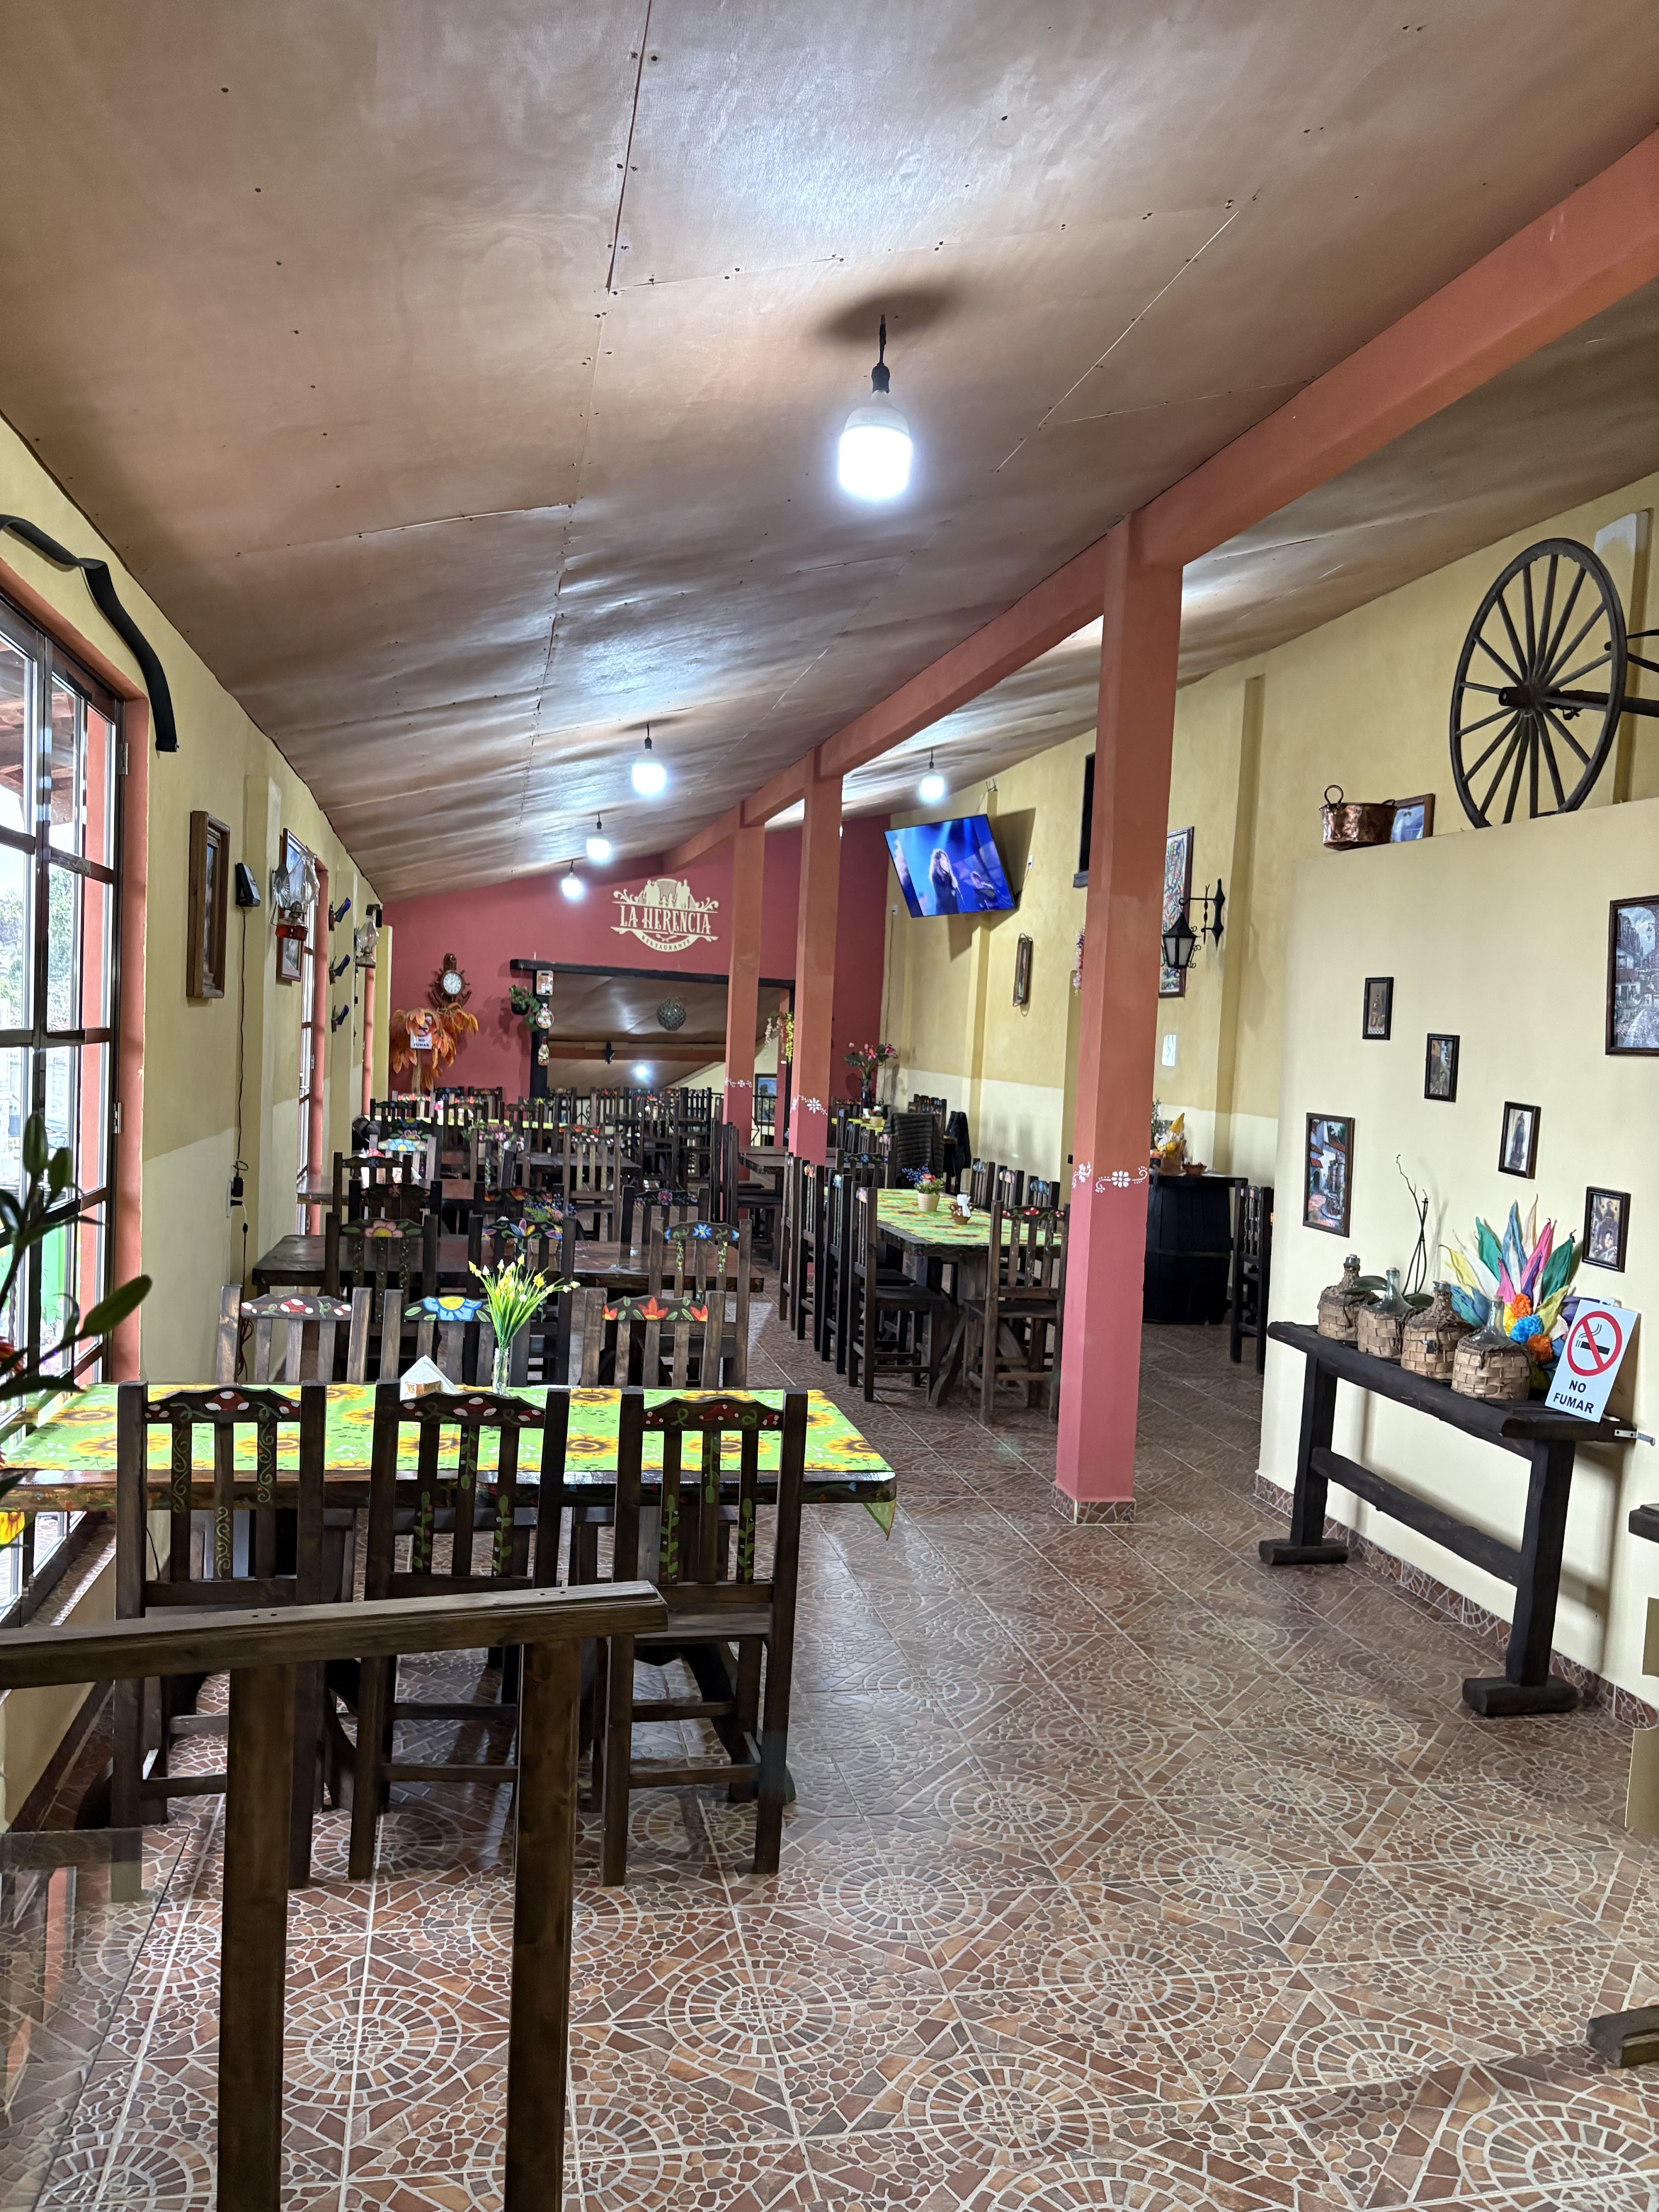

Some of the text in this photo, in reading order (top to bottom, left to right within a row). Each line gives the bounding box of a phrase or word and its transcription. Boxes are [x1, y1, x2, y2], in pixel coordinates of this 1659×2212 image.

[619, 905, 711, 935] LA HERENCIA
[641, 935, 690, 951] RESTAURANTE
[1569, 1380, 1586, 1393] NO
[1553, 1393, 1594, 1414] FUMAR
